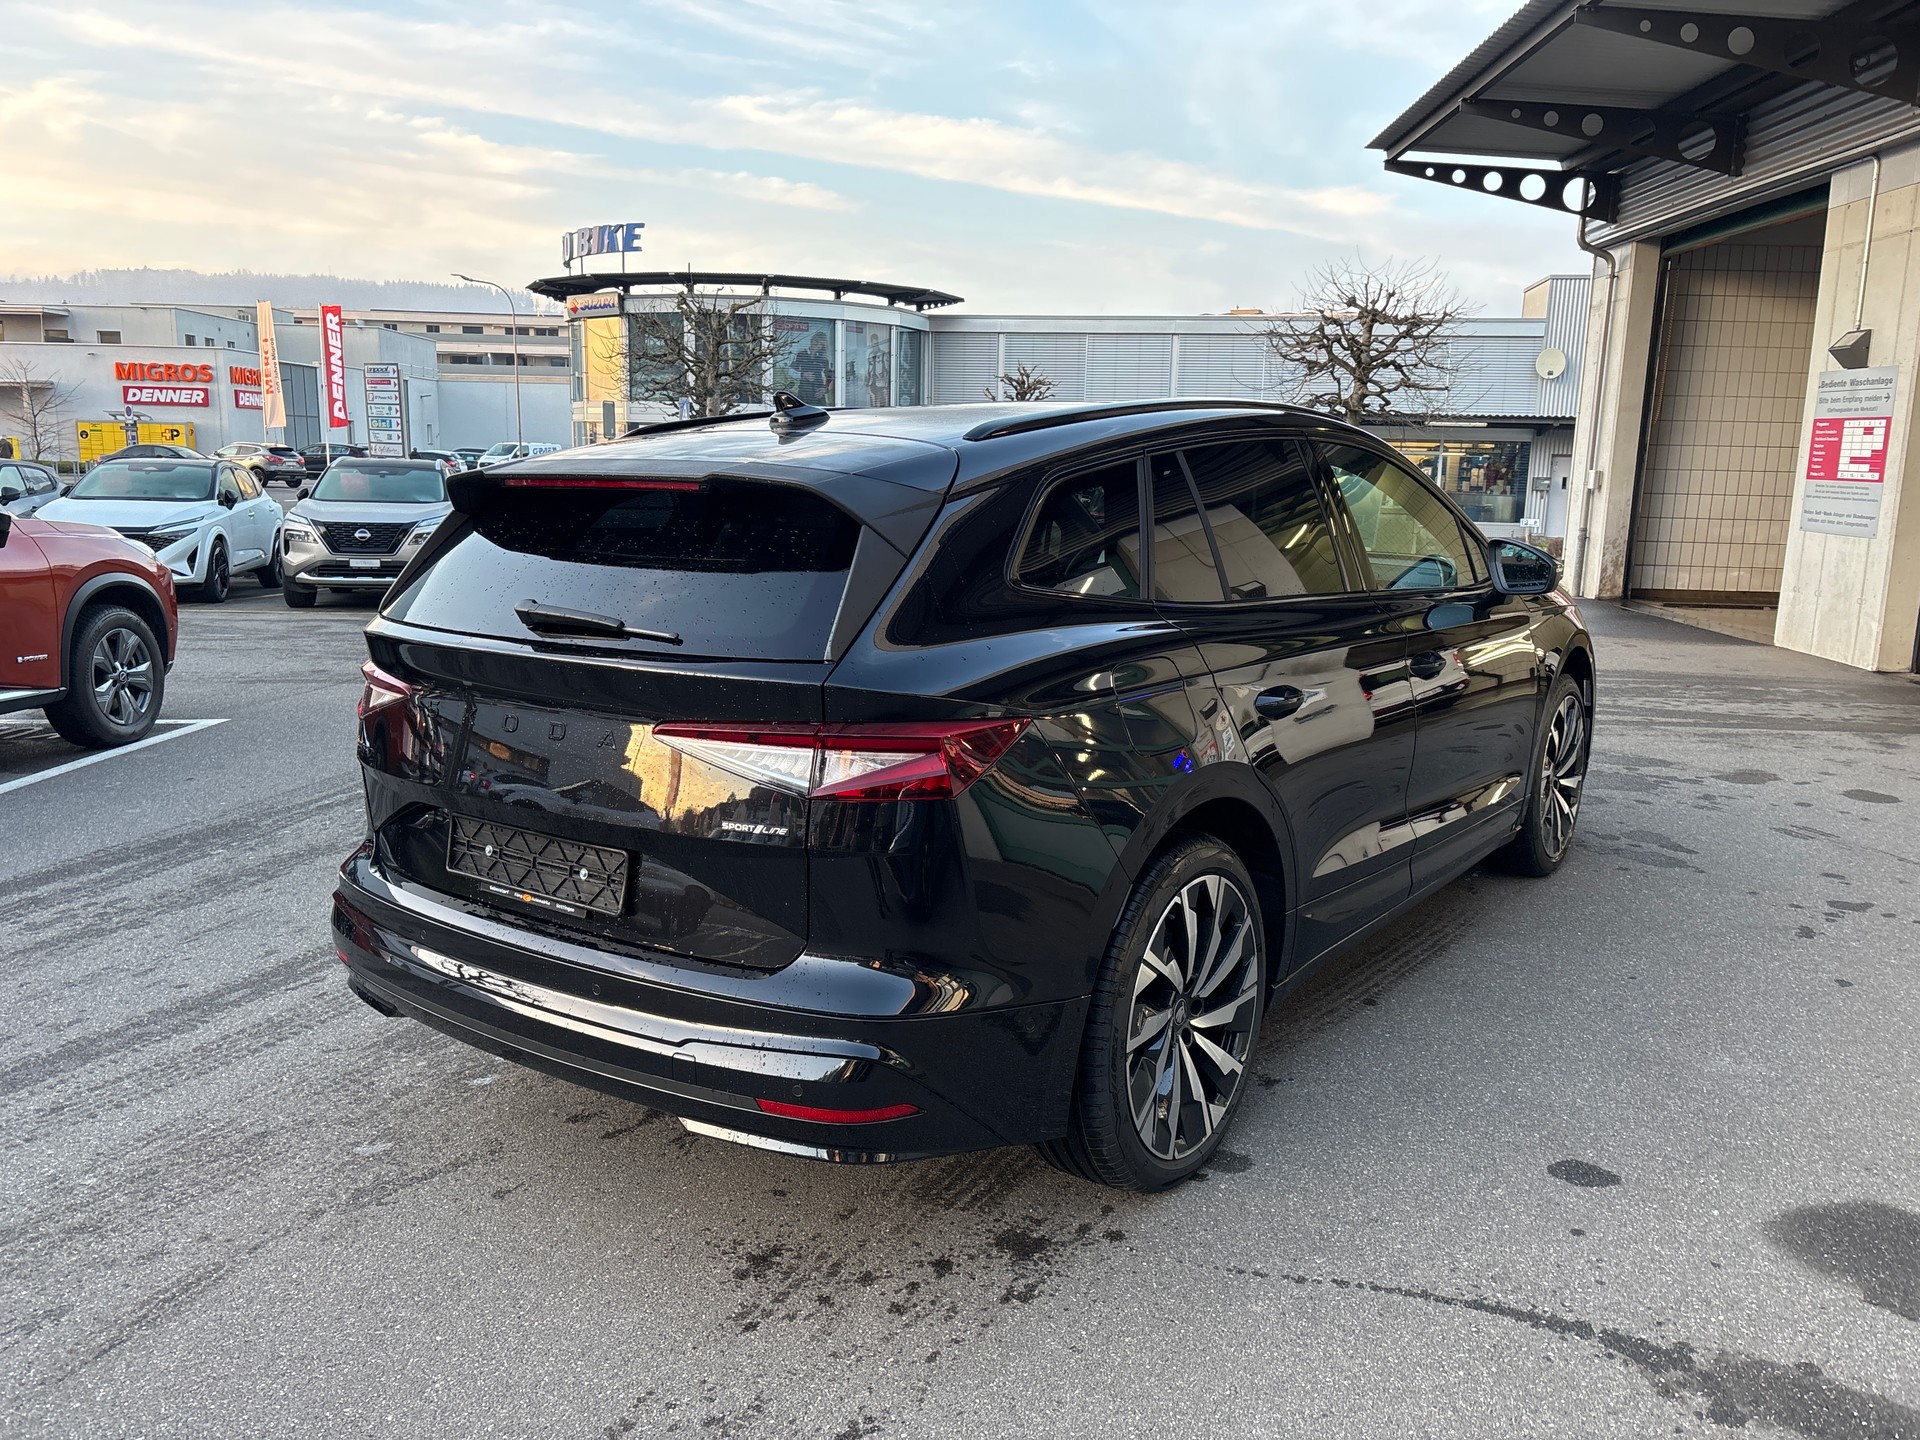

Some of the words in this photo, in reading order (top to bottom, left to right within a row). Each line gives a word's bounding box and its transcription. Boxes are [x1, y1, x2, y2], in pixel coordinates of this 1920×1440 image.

[577, 223, 645, 256] BIKE
[580, 298, 615, 311] SUZUKI
[115, 362, 213, 383] MIGROS
[326, 312, 346, 420] DENNER
[1819, 380, 1847, 389] Bediente
[1850, 377, 1893, 387] Waschanlage
[127, 388, 205, 404] DENNER
[1842, 395, 1863, 404] Empfang
[1864, 394, 1882, 402] melden
[721, 822, 755, 832] SPORT
